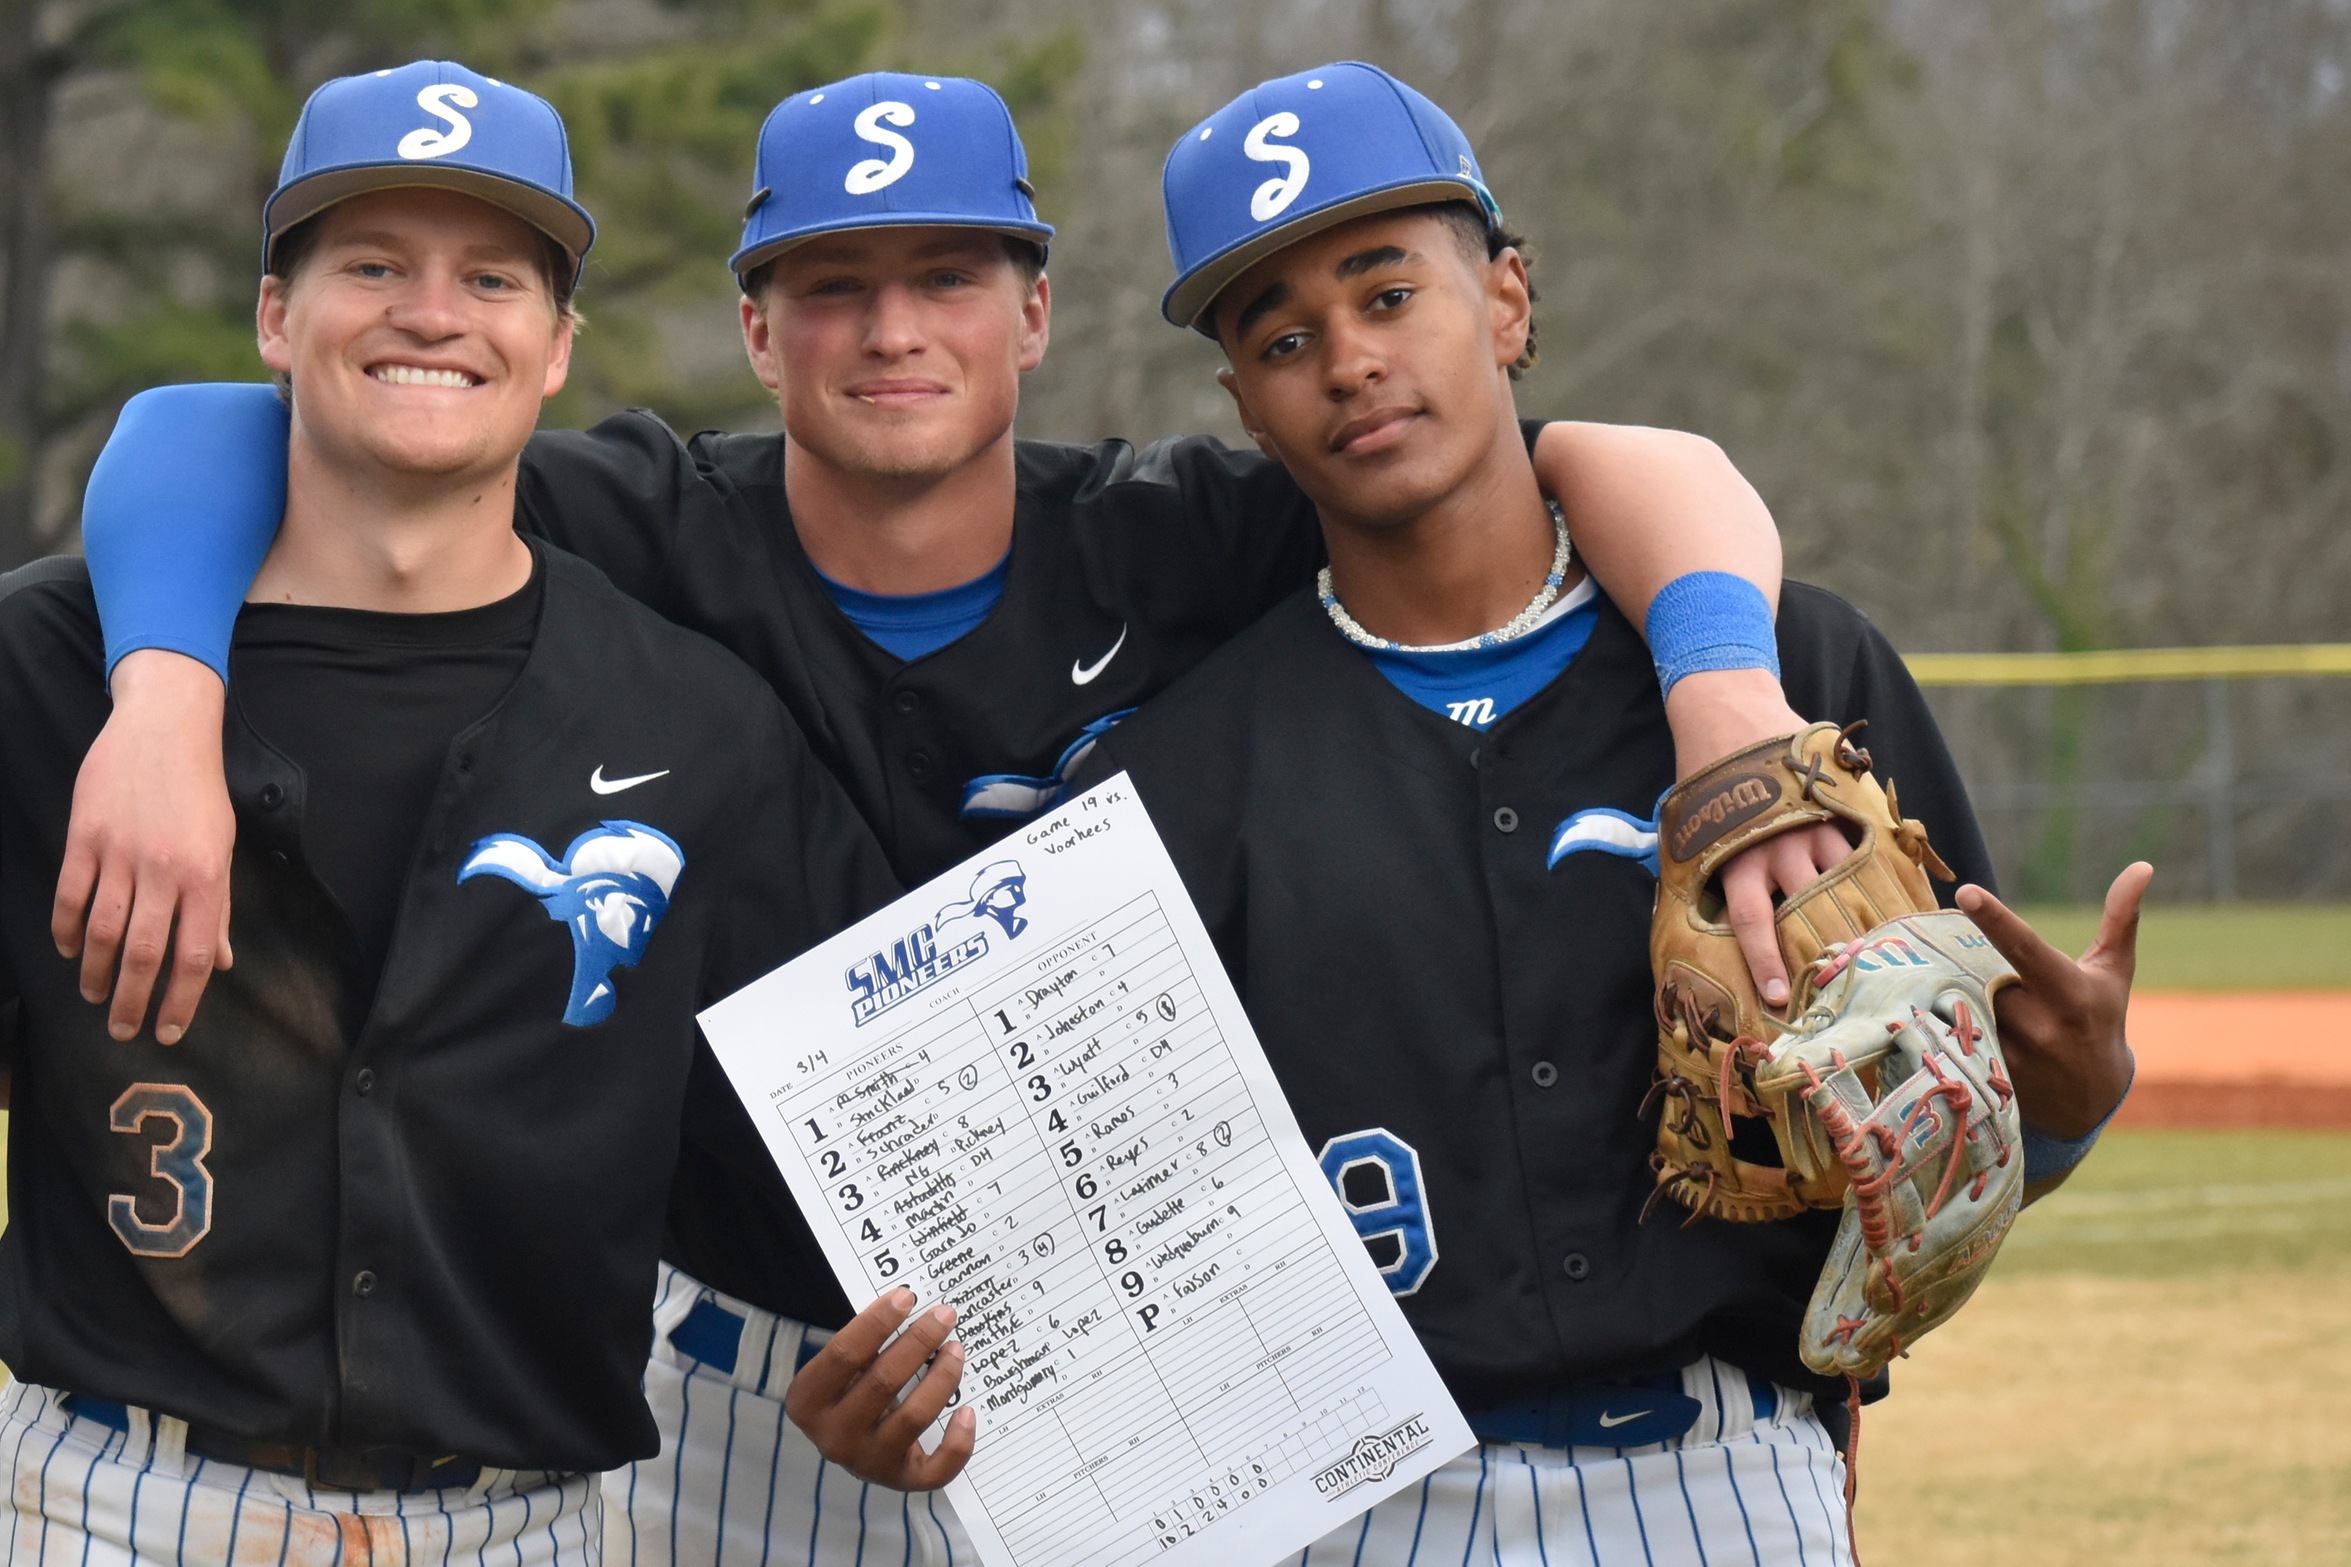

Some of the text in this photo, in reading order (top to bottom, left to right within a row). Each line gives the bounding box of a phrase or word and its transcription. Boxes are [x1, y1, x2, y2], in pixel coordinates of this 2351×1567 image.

[397, 84, 479, 160] S
[845, 101, 916, 196] S
[1243, 111, 1310, 222] S
[1026, 817, 1071, 845] Game
[1081, 796, 1098, 811] 19
[1675, 777, 1772, 847] Wilson
[1044, 818, 1111, 855] Voorhees
[845, 923, 938, 999] SMC
[1037, 932, 1096, 971] OPPONENT
[1101, 943, 1116, 958] 7
[852, 932, 989, 1024] PIONEERS
[1024, 969, 1078, 1010] Drayton
[1117, 980, 1129, 993] 4
[929, 987, 960, 1009] COACH
[993, 1009, 1018, 1036] 1
[796, 1049, 829, 1074] 3/4
[846, 1044, 904, 1081] PIONEERS
[918, 1049, 931, 1063] 4
[1009, 1041, 1035, 1070] 2
[1058, 1037, 1102, 1076] Wyatt
[769, 1082, 793, 1100] DATE
[935, 1077, 951, 1095] 5
[1027, 1074, 1052, 1102] 3
[1076, 1062, 1130, 1105] Guilford
[1165, 1070, 1179, 1089] 3
[957, 1115, 970, 1129] 8
[1048, 1108, 1069, 1134] 4
[1090, 1105, 1135, 1140] Ramos
[1181, 1108, 1195, 1121] 2
[804, 1117, 829, 1144] 1
[969, 1146, 994, 1167] DH
[1059, 1138, 1083, 1168] 5
[1105, 1136, 1149, 1171] Reyes
[1195, 1140, 1208, 1157] 8
[108, 1082, 213, 1259] 3
[820, 1150, 847, 1179] 2
[987, 1181, 1002, 1195] 7
[1075, 1173, 1098, 1200] 6
[1119, 1158, 1178, 1201] Latimer
[1211, 1176, 1224, 1190] 6
[838, 1183, 864, 1211] 3
[1004, 1215, 1019, 1230] 2
[1087, 1204, 1106, 1233] 7
[1226, 1205, 1242, 1218] 9
[1317, 1127, 1439, 1298] 9
[860, 1217, 883, 1243] 4
[873, 1248, 900, 1278] 5
[1017, 1249, 1030, 1267] 3
[1104, 1238, 1128, 1265] 8
[1274, 1260, 1286, 1271] RH
[1032, 1280, 1045, 1296] 9
[1120, 1271, 1145, 1298] 9
[1219, 1284, 1248, 1304] EXTRAS
[1048, 1314, 1060, 1329] 6
[1136, 1303, 1160, 1333] P
[1182, 1316, 1193, 1326] LH
[1311, 1326, 1323, 1337] RH
[1255, 1345, 1292, 1370] PITCHERS
[1091, 1369, 1103, 1380] RH
[1219, 1382, 1230, 1392] LH
[1035, 1392, 1065, 1413] EXTRAS
[998, 1425, 1009, 1435] LH
[1128, 1436, 1140, 1447] RH
[1073, 1455, 1109, 1480] PITCHERS
[1311, 1420, 1430, 1494] CONTINENTAL
[1336, 1439, 1419, 1493] ATHLETIC CONFERENCE
[1035, 1492, 1047, 1502] LH
[1154, 1464, 1263, 1530] 0 1 0 0 0 0
[1159, 1478, 1268, 1549] 10 2 2 4 0 0
